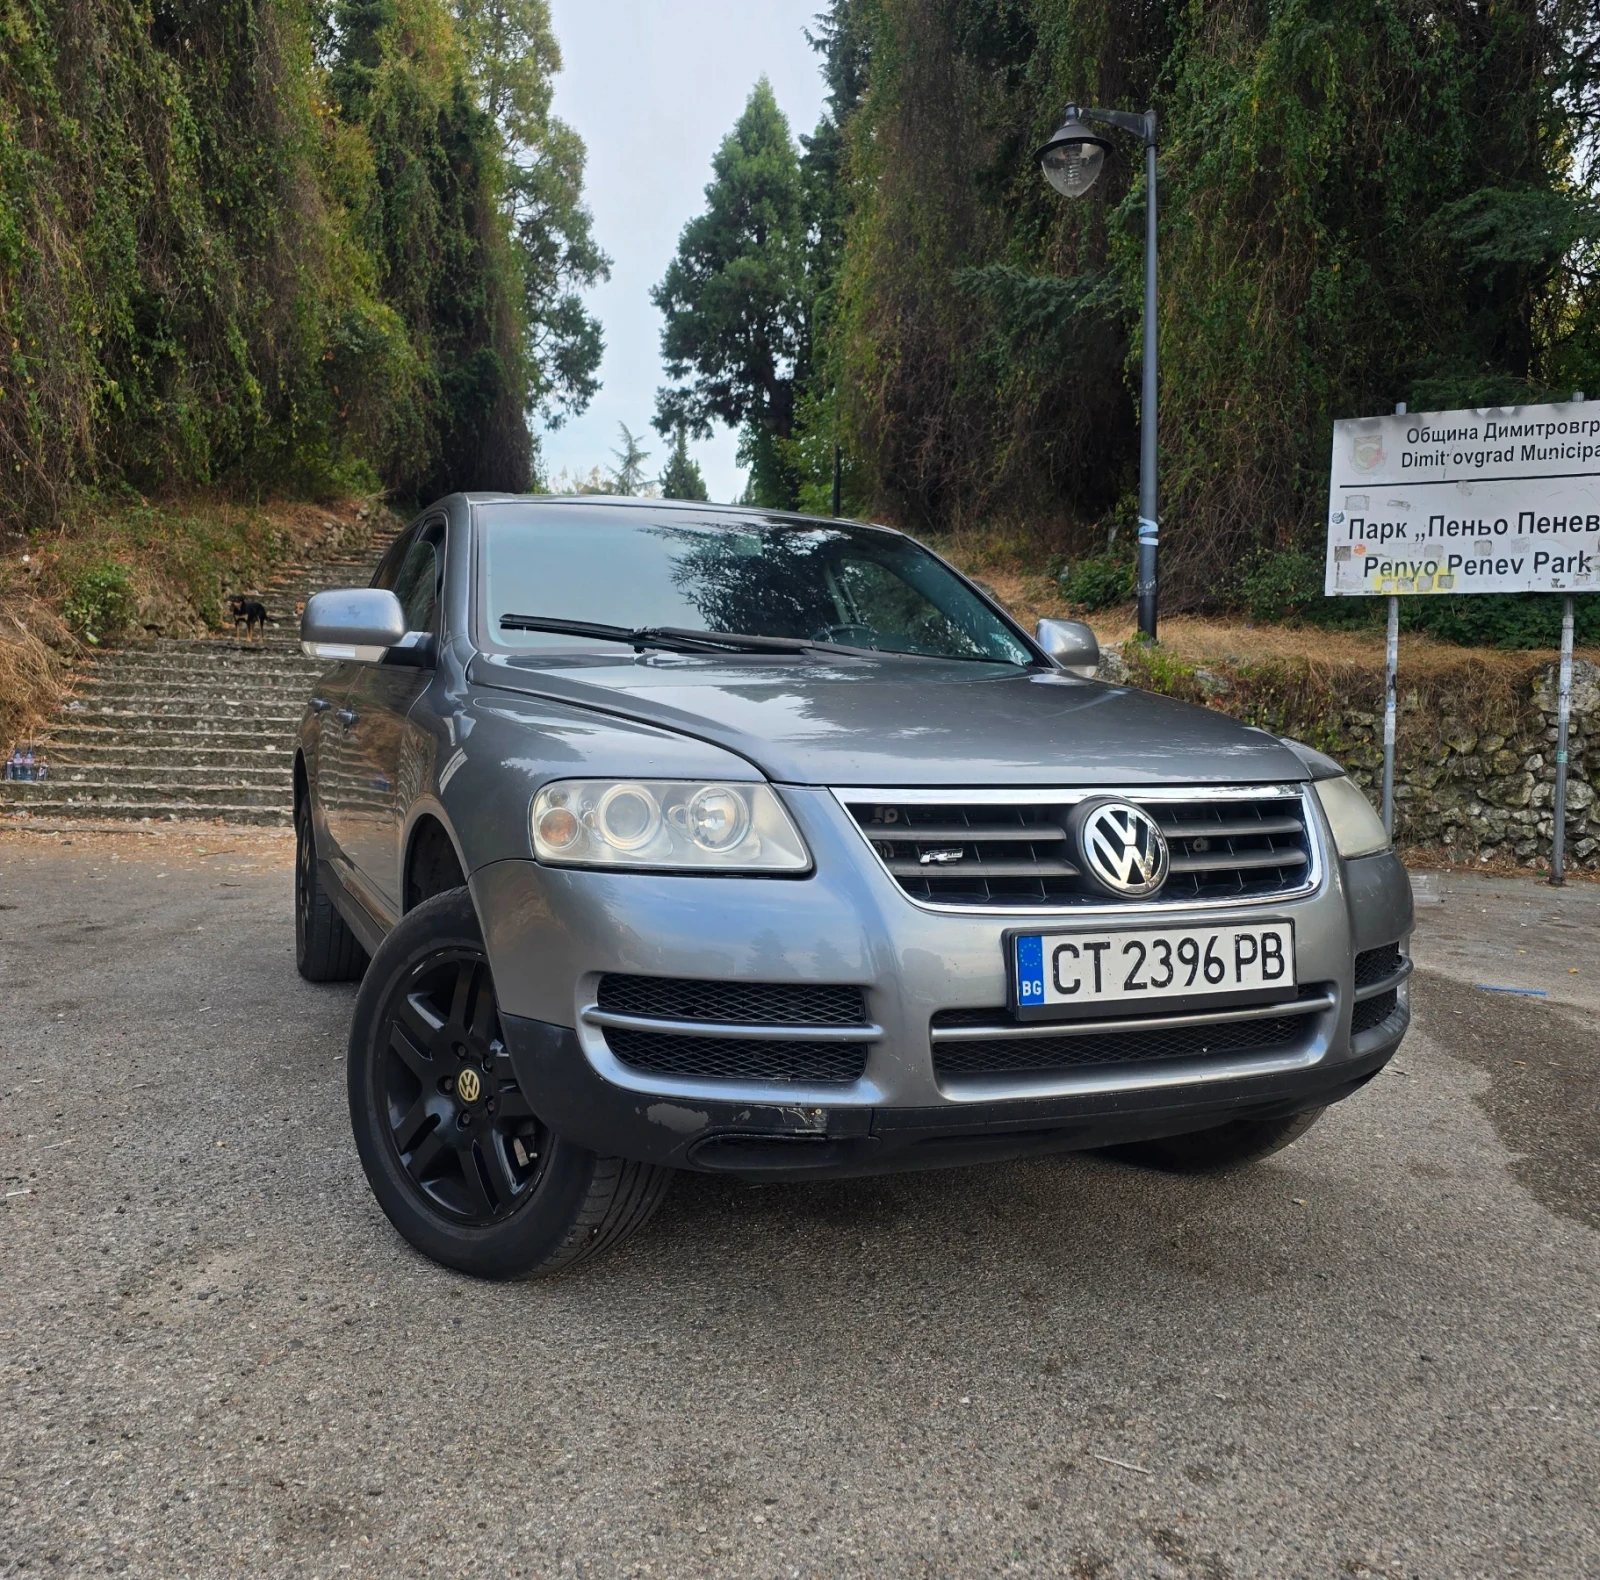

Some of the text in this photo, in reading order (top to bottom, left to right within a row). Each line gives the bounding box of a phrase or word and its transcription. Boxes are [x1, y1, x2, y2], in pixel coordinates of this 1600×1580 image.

[1407, 425, 1478, 444] Община
[1349, 518, 1407, 544] Парк
[1517, 512, 1600, 534] Пенев
[1364, 550, 1592, 581] Penyo Penev Park
[1122, 935, 1225, 991] 2396
[1022, 980, 1042, 996] BG
